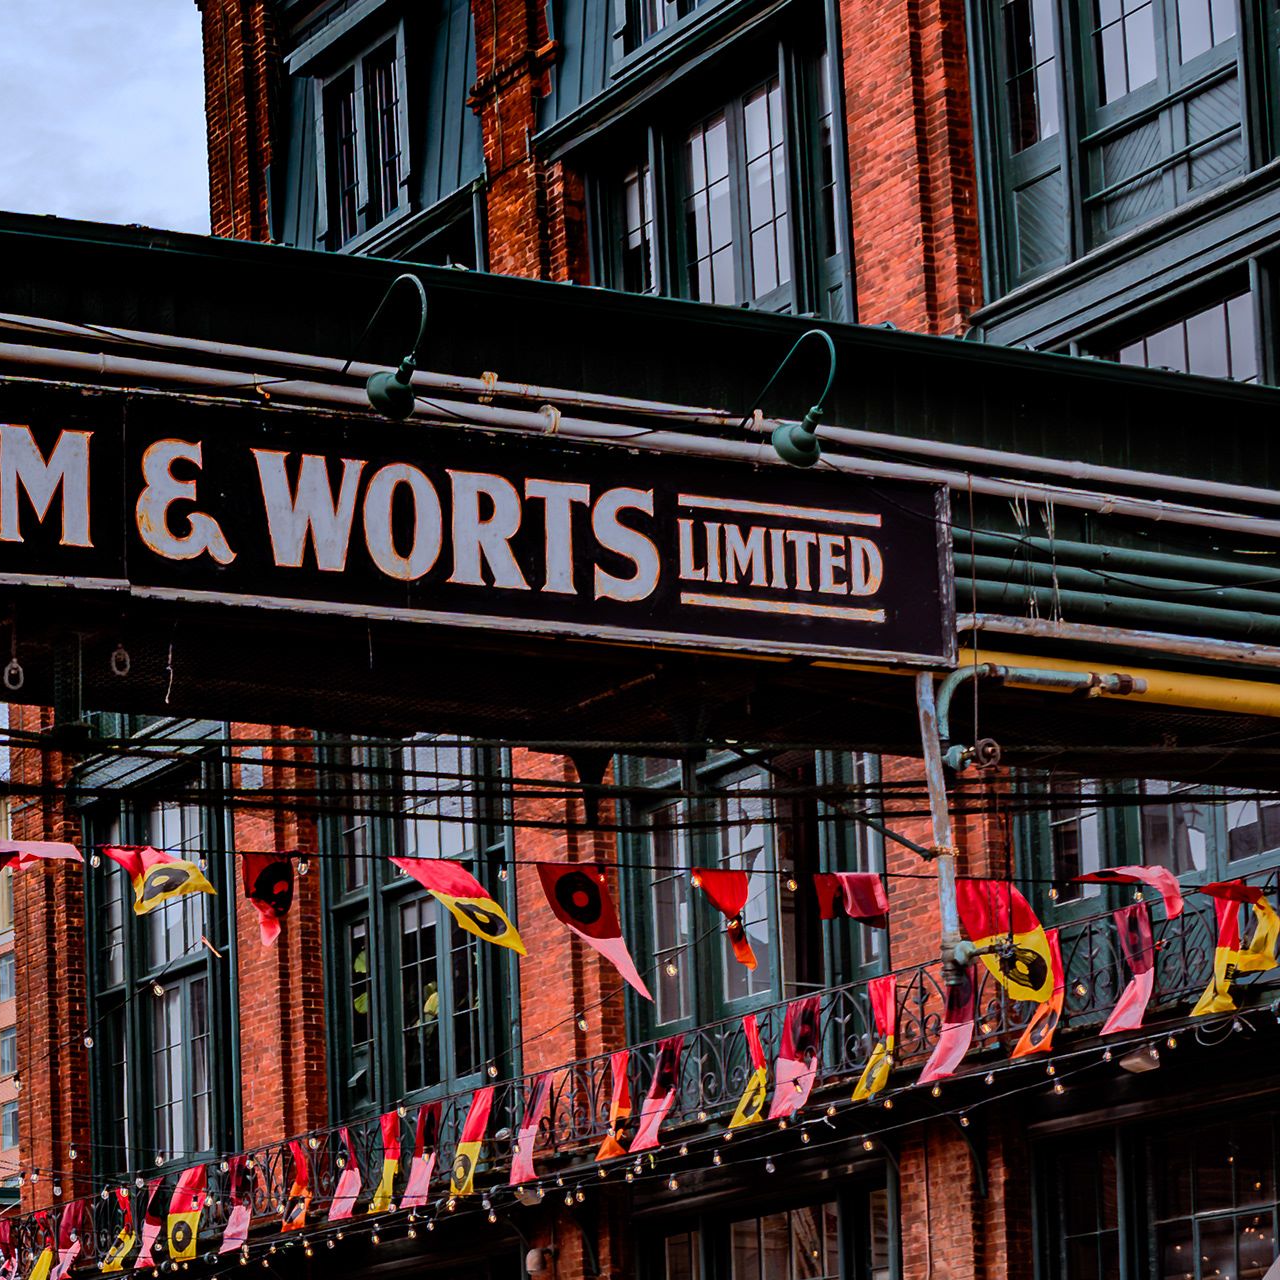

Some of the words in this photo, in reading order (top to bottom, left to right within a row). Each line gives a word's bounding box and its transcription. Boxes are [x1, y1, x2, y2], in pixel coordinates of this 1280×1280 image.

[135, 438, 238, 565] &
[250, 446, 661, 602] WORTS
[676, 517, 884, 597] LIMITED
